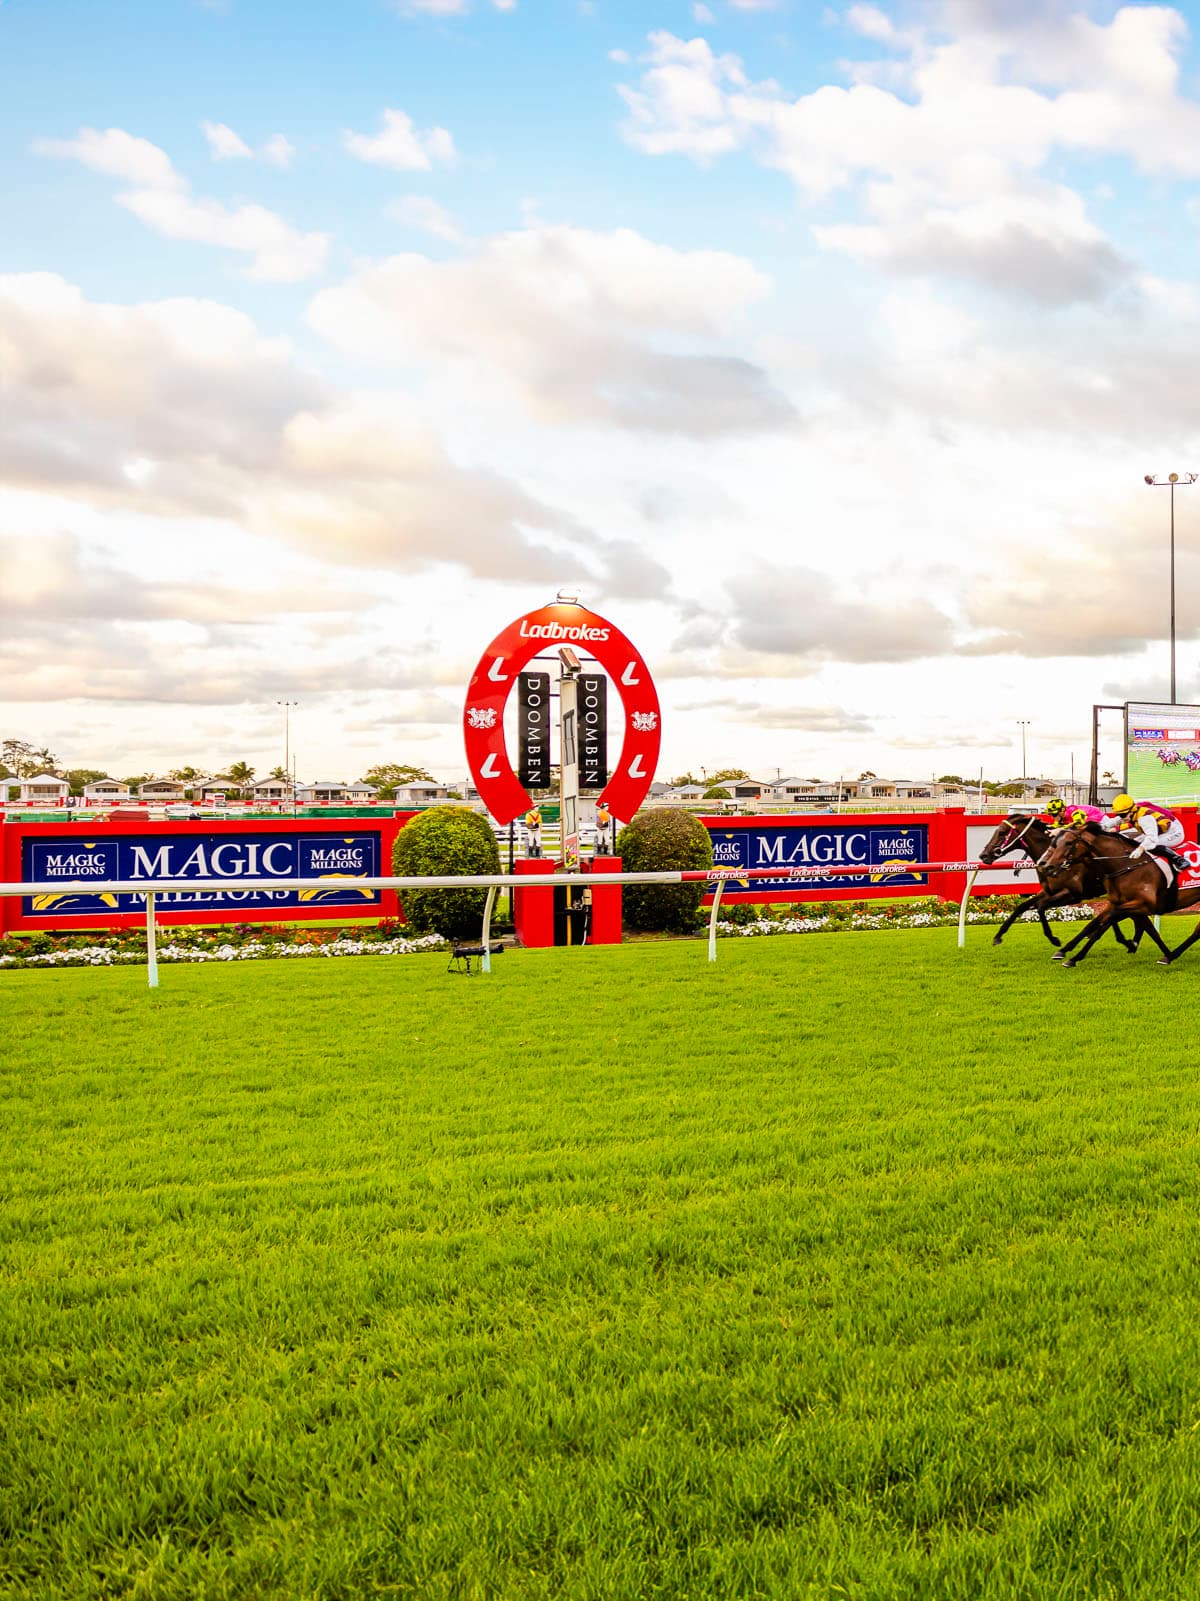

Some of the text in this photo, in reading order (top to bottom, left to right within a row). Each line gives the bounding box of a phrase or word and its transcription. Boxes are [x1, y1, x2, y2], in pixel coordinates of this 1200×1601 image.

[519, 620, 611, 641] Ladbrokes
[527, 678, 541, 783] DOOMBEN
[585, 679, 598, 783] DOOMBEN
[712, 843, 740, 854] AGIC
[756, 833, 866, 864] MAGIC
[878, 838, 914, 849] MAGIC
[311, 849, 363, 861] MAGIC
[878, 848, 914, 857] MILLIONS
[46, 854, 106, 868] MAGIC
[129, 843, 293, 879] MAGIC
[311, 860, 363, 870] MILLIONS
[942, 861, 979, 871] Ladbrokes
[1013, 859, 1036, 868] Ladbro
[46, 866, 106, 876] MILLIONS
[789, 866, 830, 878] Ladbrokes
[868, 864, 907, 874] Ladbrokes
[706, 870, 750, 880] Ladbrokes
